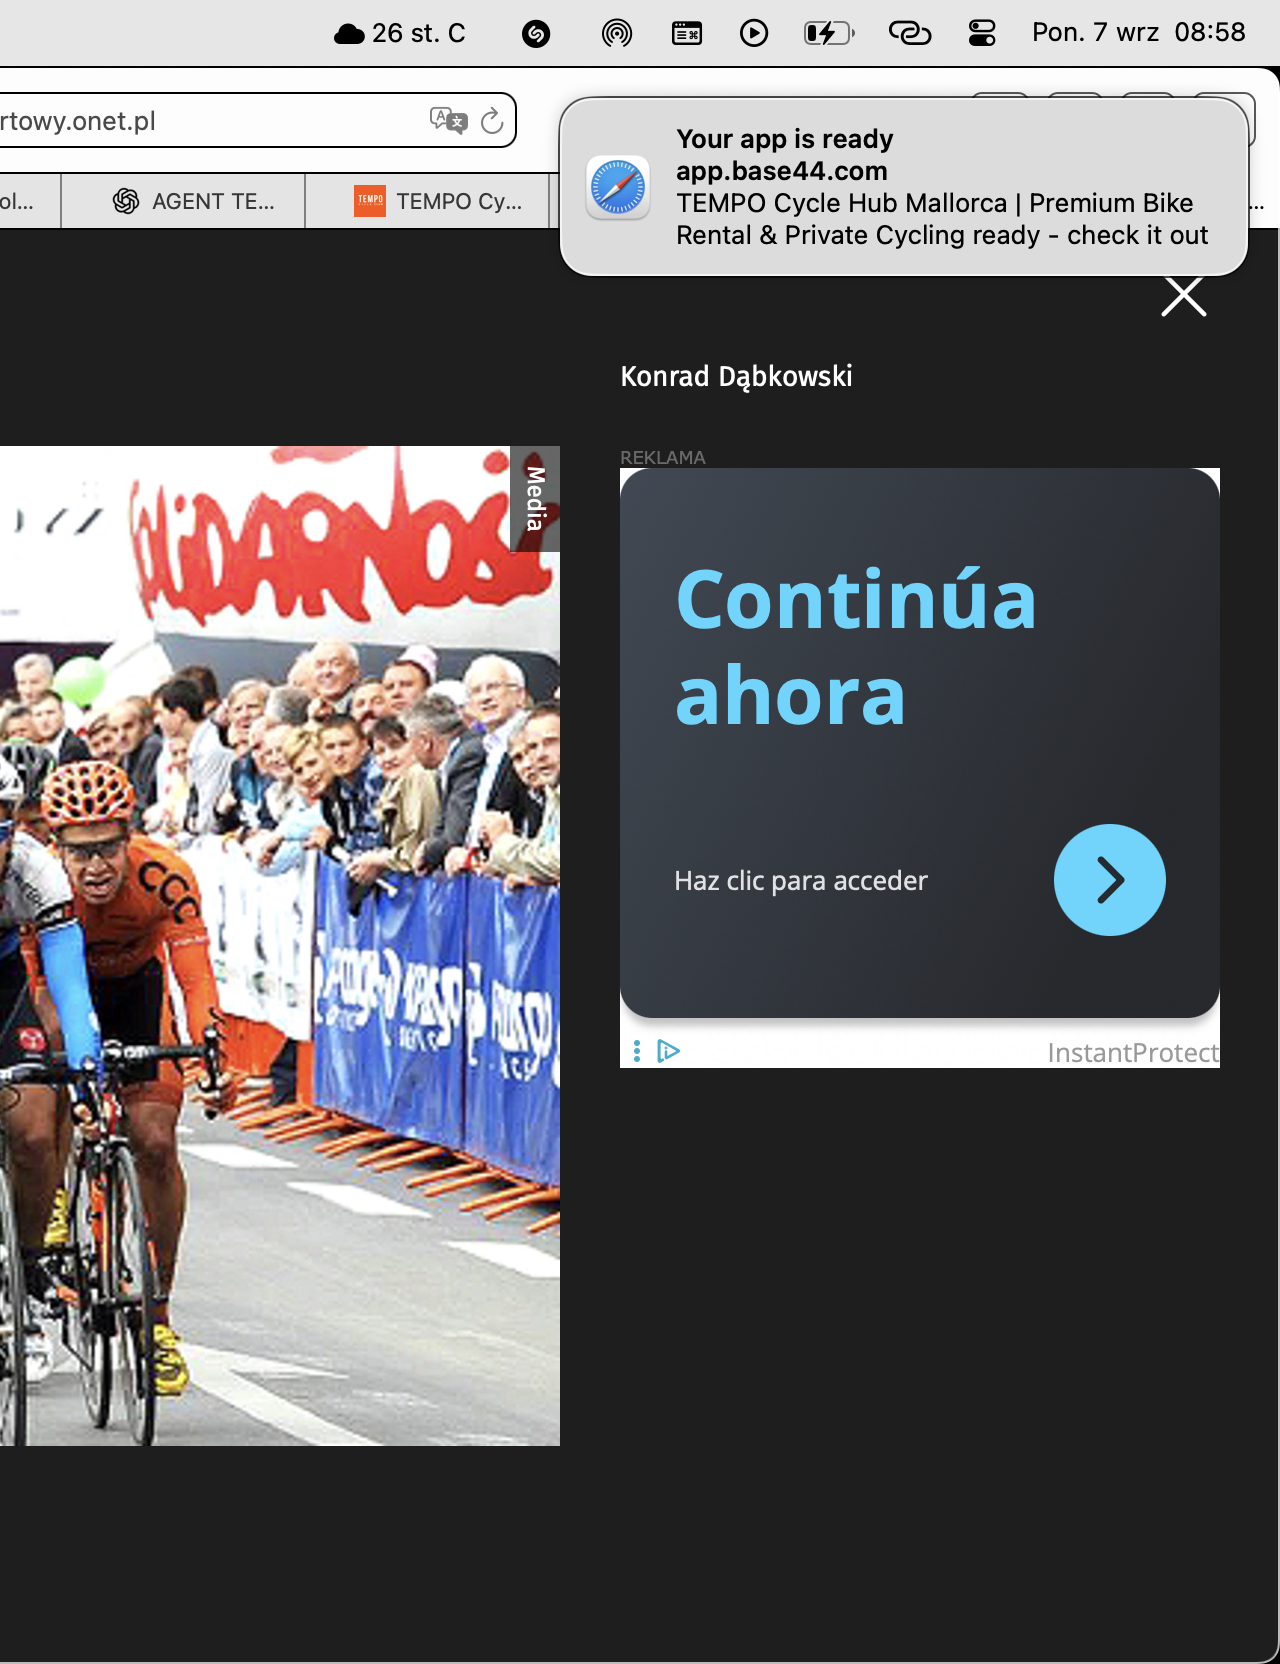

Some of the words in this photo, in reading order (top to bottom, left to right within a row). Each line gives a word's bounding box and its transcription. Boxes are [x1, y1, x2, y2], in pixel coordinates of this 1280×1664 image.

[373, 23, 402, 43] 26
[412, 24, 439, 43] st.
[449, 23, 465, 43] C
[1034, 22, 1084, 42] Pon.
[1094, 22, 1107, 42] 7
[1117, 27, 1159, 42] wrz
[1175, 22, 1245, 42] 08:58
[677, 129, 733, 149] Your
[741, 133, 787, 154] app
[795, 128, 814, 149] is
[824, 128, 893, 154] ready
[677, 160, 887, 186] app.base44.com
[153, 192, 224, 210] AGENT
[358, 194, 383, 203] TEMPO
[397, 192, 472, 210] TEMPO
[677, 193, 765, 213] TEMPO
[775, 192, 840, 218] Cycle
[850, 192, 897, 213] Hub
[907, 192, 1006, 213] Mallorca
[1031, 192, 1134, 213] Premium
[1144, 192, 1193, 213] Bike
[678, 224, 750, 245] Rental
[760, 225, 777, 245] &
[786, 224, 867, 245] Private
[877, 224, 964, 250] Cycling
[974, 224, 1040, 250] ready
[1068, 224, 1139, 245] check
[1148, 224, 1162, 245] it
[1171, 226, 1209, 245] out
[622, 364, 708, 387] Konrad
[720, 363, 852, 394] Dąbkowski
[621, 450, 706, 465] REKLAMA
[678, 566, 1034, 629] Continúa
[677, 663, 903, 725] ahora
[139, 861, 202, 925] CCC
[676, 870, 719, 890] Haz
[728, 869, 764, 890] clic
[773, 874, 825, 897] para
[834, 869, 928, 891] acceder
[1050, 1042, 1220, 1063] InstantProtect
